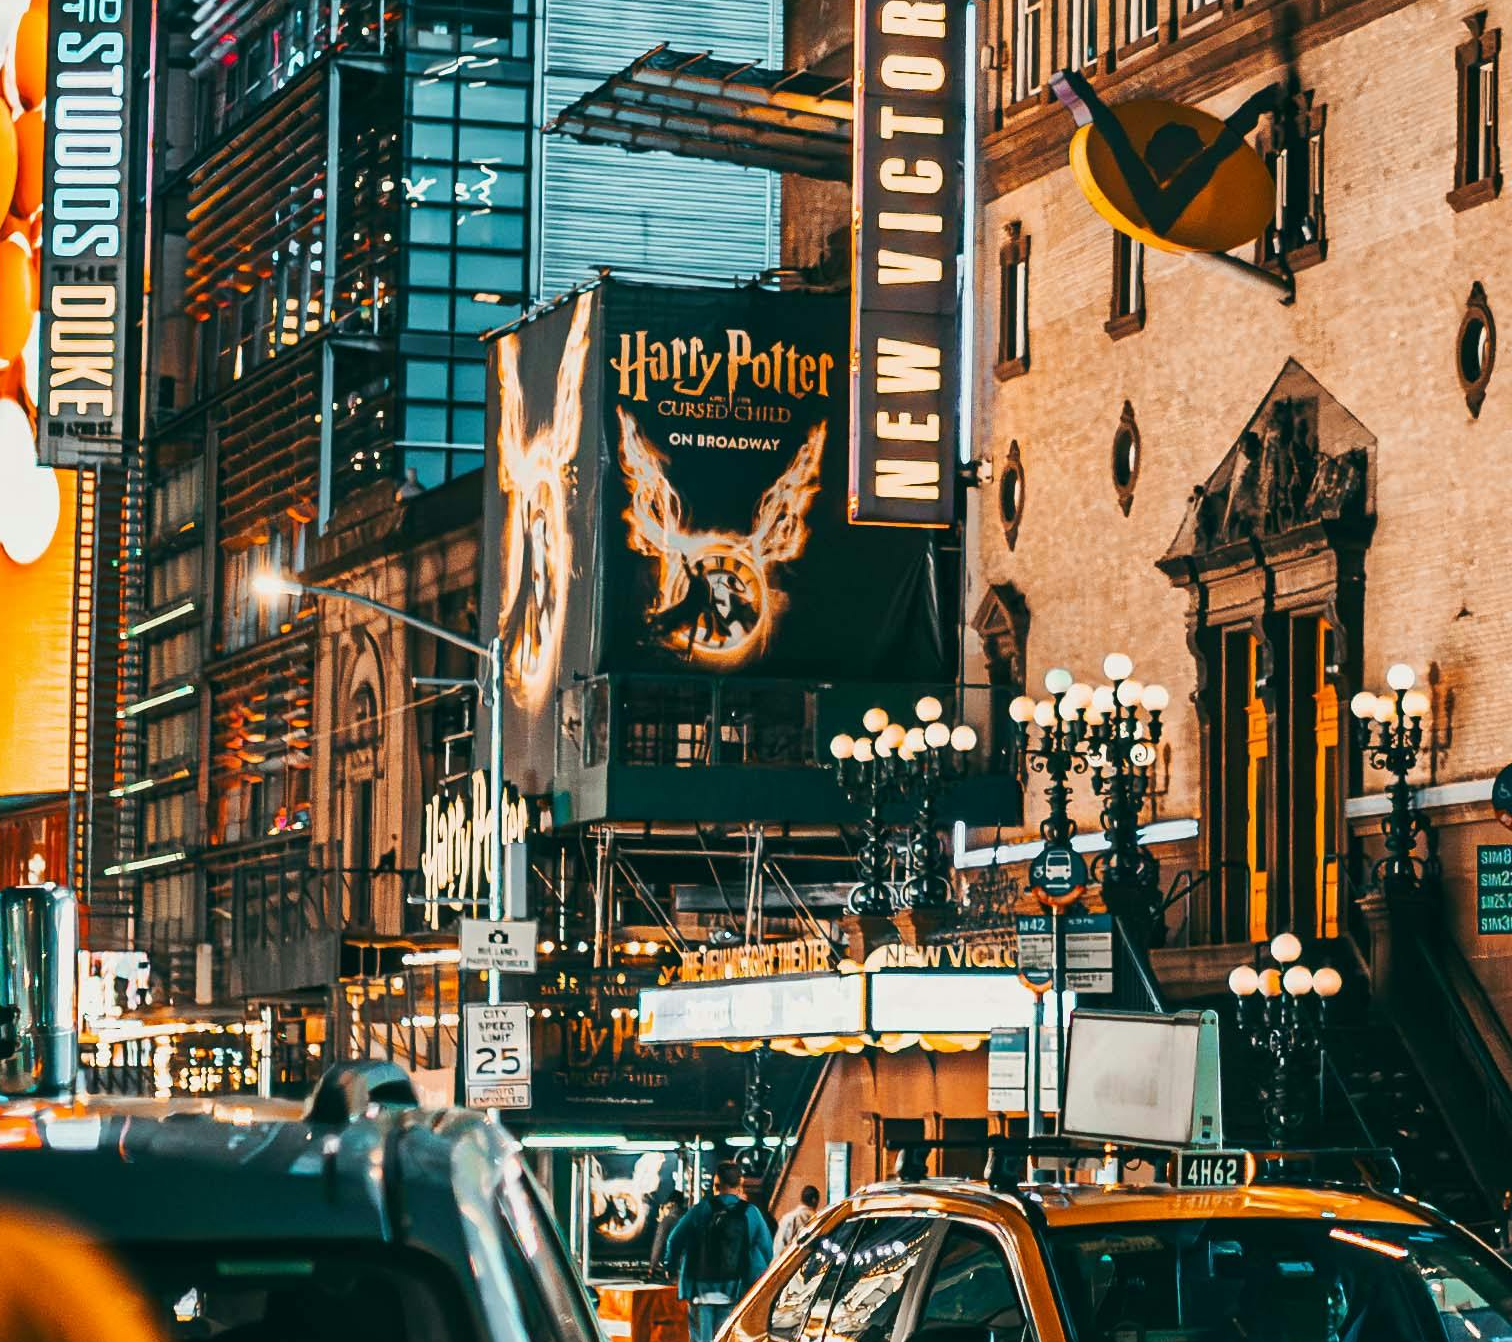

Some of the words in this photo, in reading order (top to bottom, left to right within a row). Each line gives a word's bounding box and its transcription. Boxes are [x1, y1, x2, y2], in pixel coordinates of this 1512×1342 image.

[52, 31, 125, 257] STUDIOS
[51, 264, 118, 282] THE
[48, 284, 117, 418] DUKE
[609, 330, 722, 401] Harry
[725, 329, 834, 411] Potter
[657, 400, 729, 420] CURSED
[734, 405, 792, 423] CHILD
[875, 335, 942, 501] NEW
[669, 432, 693, 446] ON
[697, 435, 781, 451] BROADWAY
[421, 793, 472, 931] Harry
[472, 768, 529, 920] Poter
[1481, 849, 1512, 865] SIM8
[478, 1020, 515, 1032] SPEED
[483, 1009, 509, 1020] CITY
[481, 1032, 512, 1044] LIMIT
[475, 1047, 521, 1075] 25
[1187, 1158, 1238, 1186] 4H62
